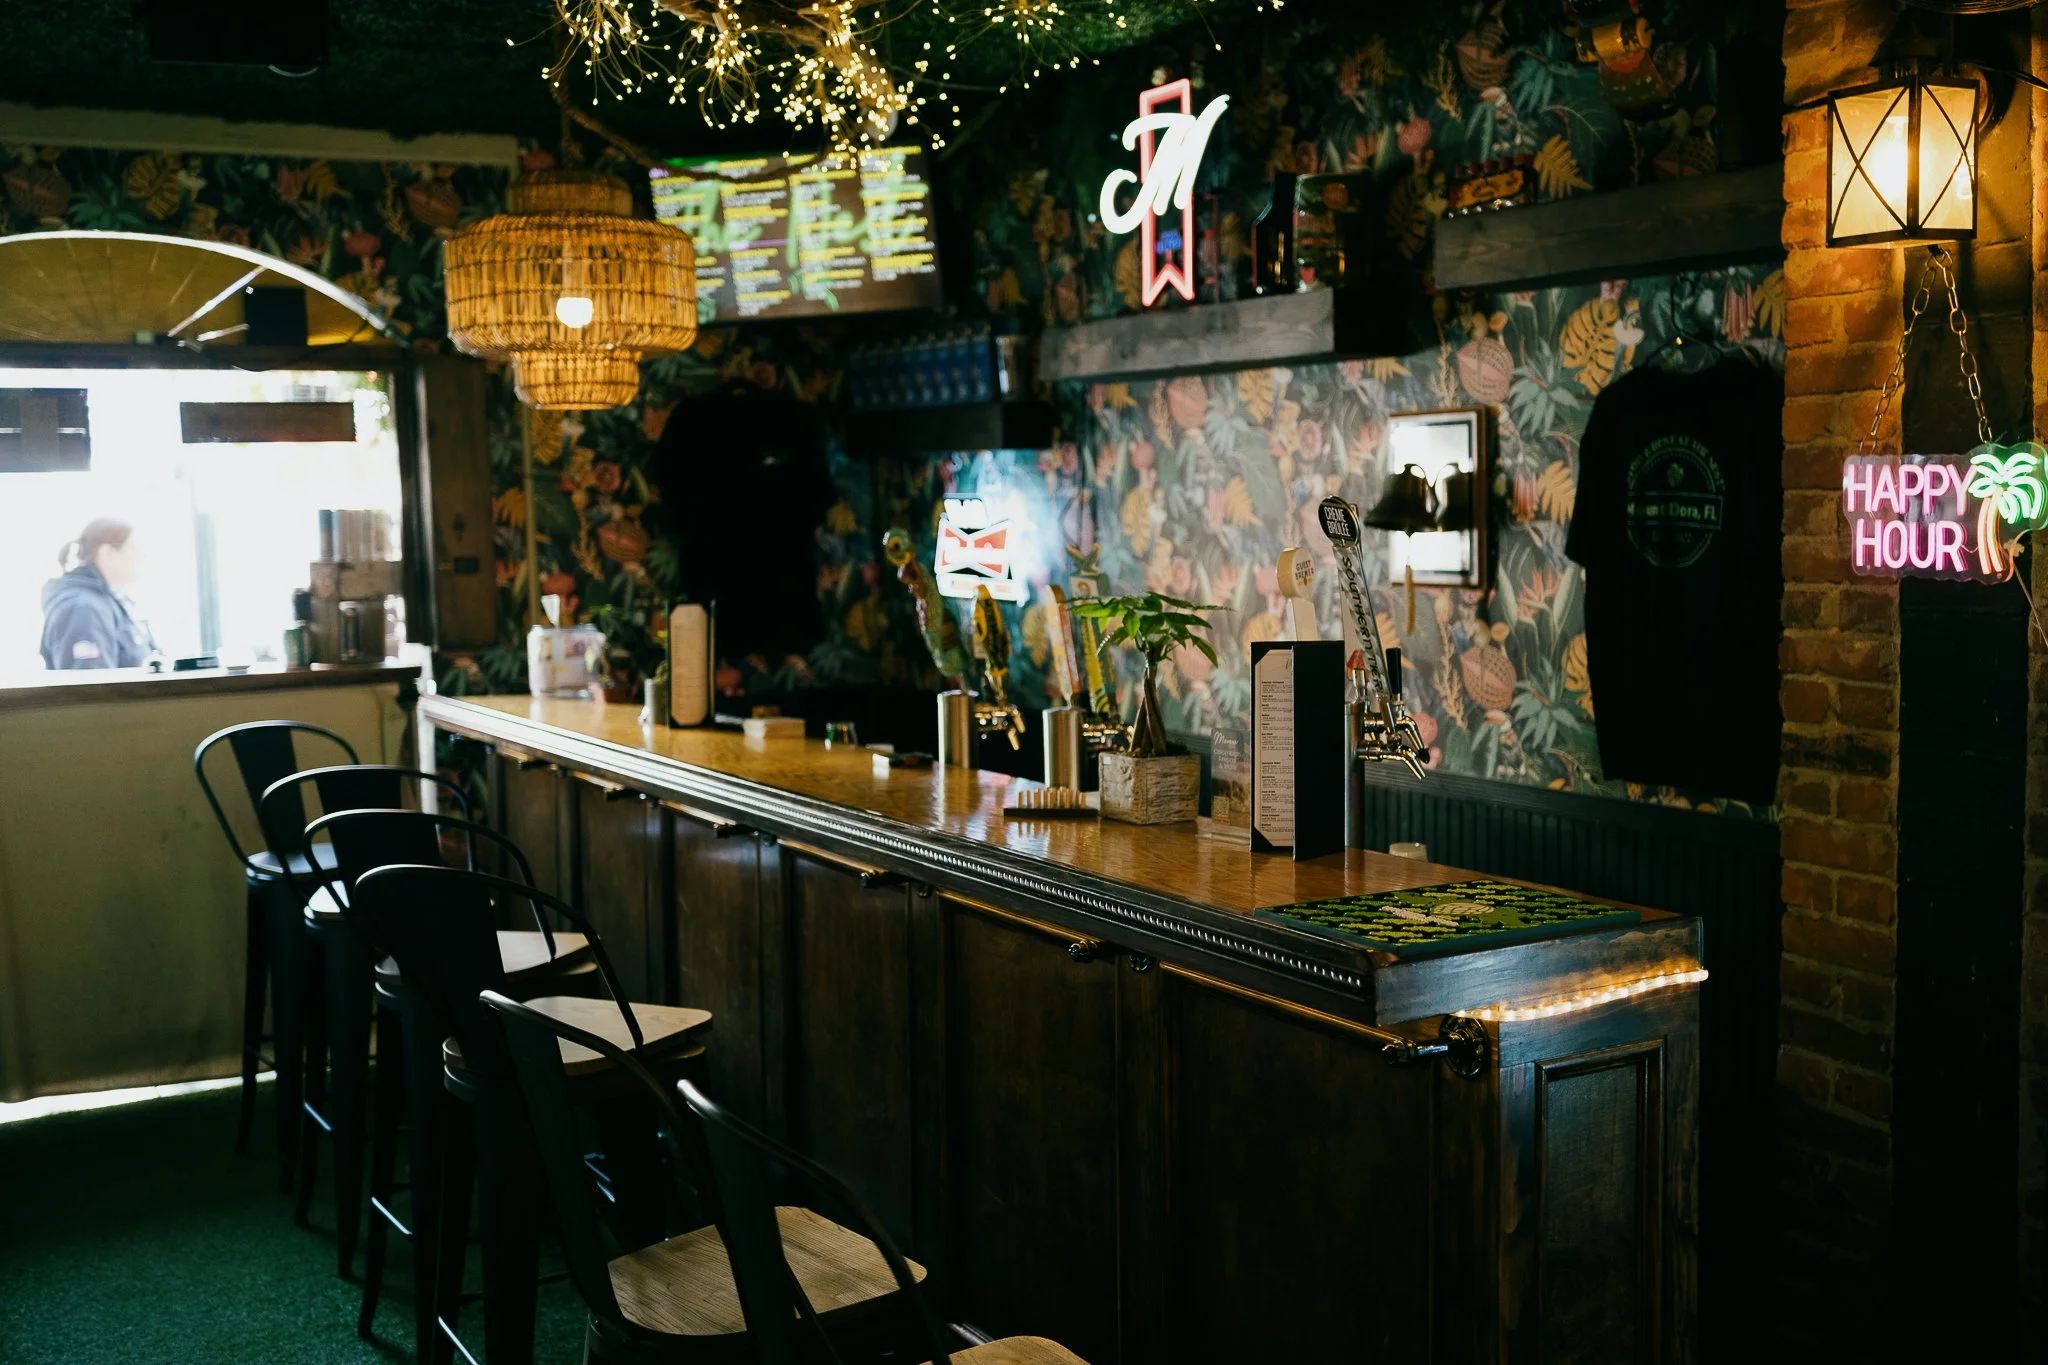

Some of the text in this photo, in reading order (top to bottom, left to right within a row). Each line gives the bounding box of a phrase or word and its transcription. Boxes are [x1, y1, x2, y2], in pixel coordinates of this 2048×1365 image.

[1847, 463, 1977, 516] HAPPY
[1856, 518, 1968, 572] HOUR
[1295, 560, 1311, 571] GUEST
[1368, 654, 1384, 694] TIER
[1213, 730, 1239, 746] Menu
